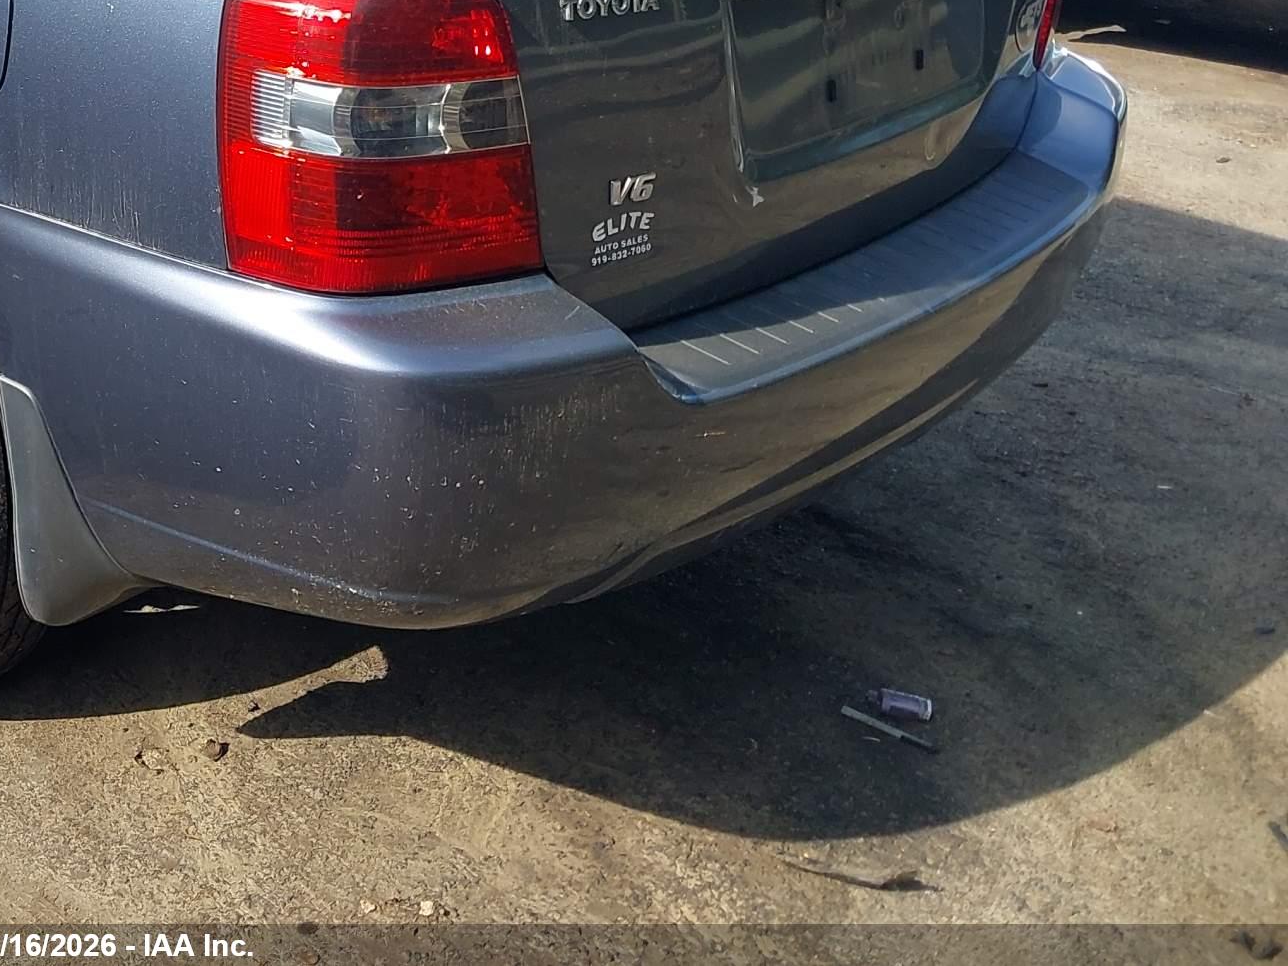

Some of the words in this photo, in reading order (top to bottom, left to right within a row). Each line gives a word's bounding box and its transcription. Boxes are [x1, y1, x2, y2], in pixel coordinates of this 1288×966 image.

[610, 173, 656, 205] V6
[592, 212, 654, 242] ELITE
[594, 241, 619, 254] AUTO
[621, 234, 649, 248] SALES
